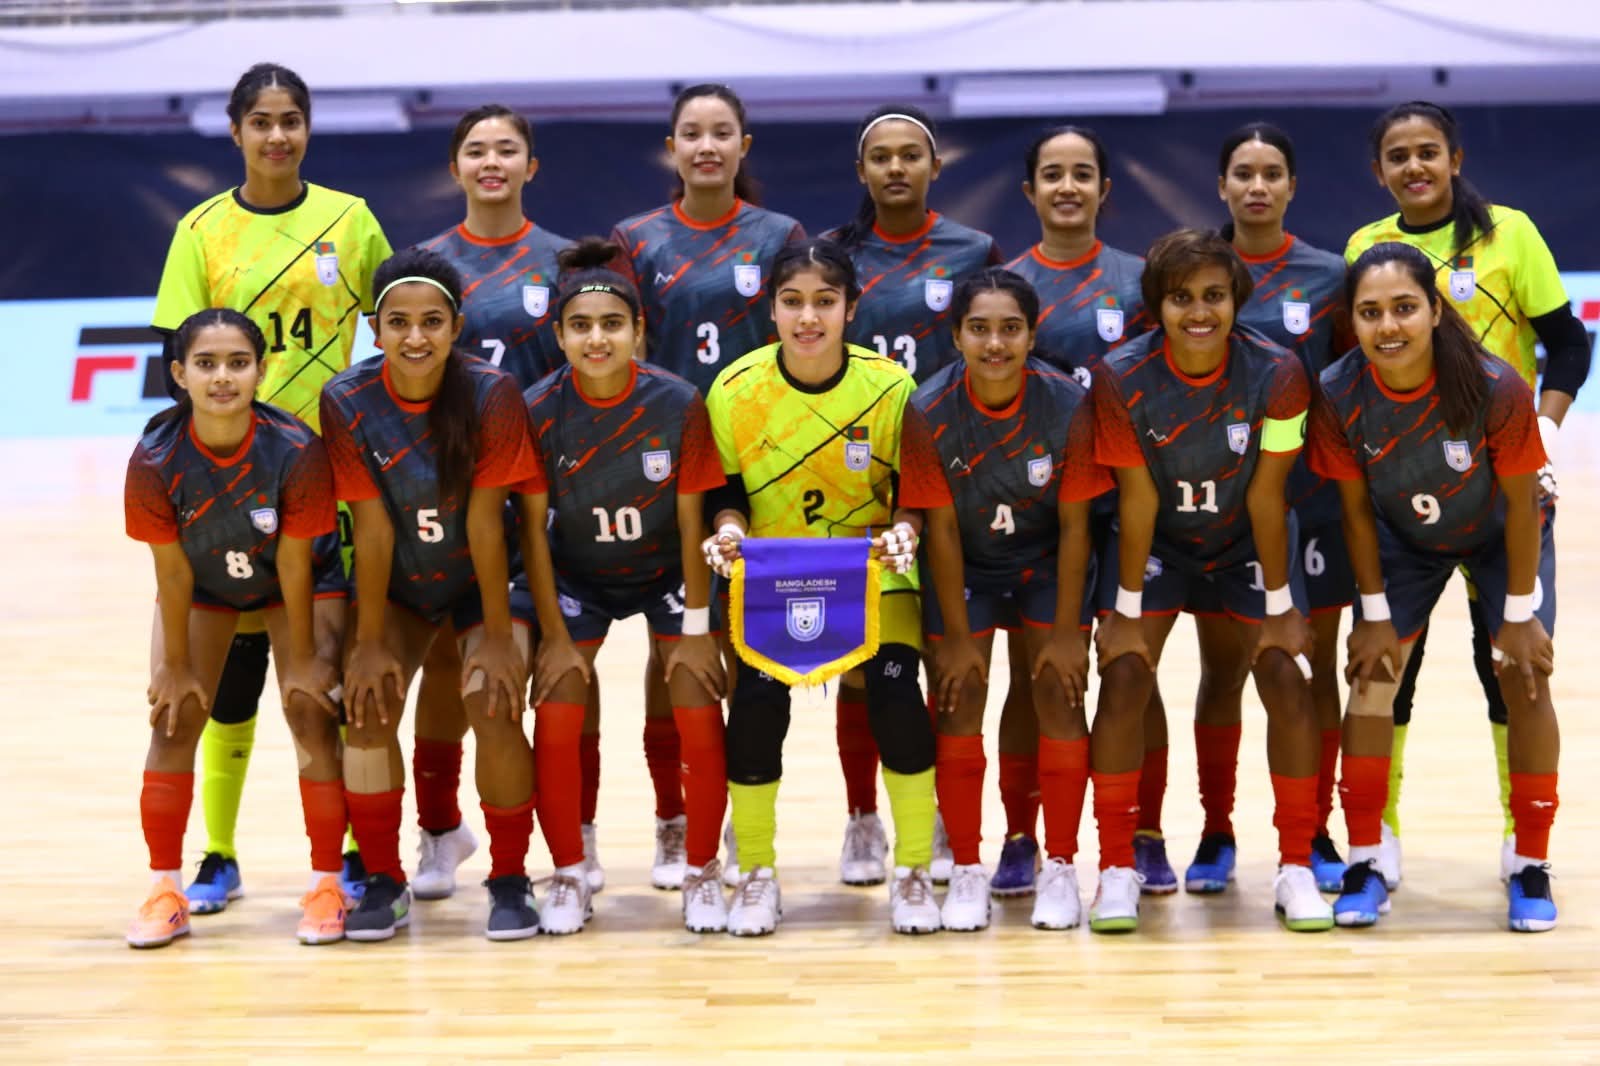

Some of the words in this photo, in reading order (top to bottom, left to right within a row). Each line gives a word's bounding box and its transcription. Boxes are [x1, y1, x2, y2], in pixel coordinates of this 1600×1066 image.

[268, 308, 313, 353] 14
[696, 322, 721, 365] 3
[481, 339, 506, 367] 7
[873, 335, 917, 376] 13
[803, 489, 825, 525] 2
[1176, 480, 1219, 513] 11
[1411, 493, 1441, 525] 9
[416, 508, 445, 543] 5
[592, 507, 643, 542] 10
[990, 503, 1016, 534] 4
[225, 550, 254, 579] 8
[1305, 538, 1325, 576] 6
[775, 579, 837, 588] BANGLADESH
